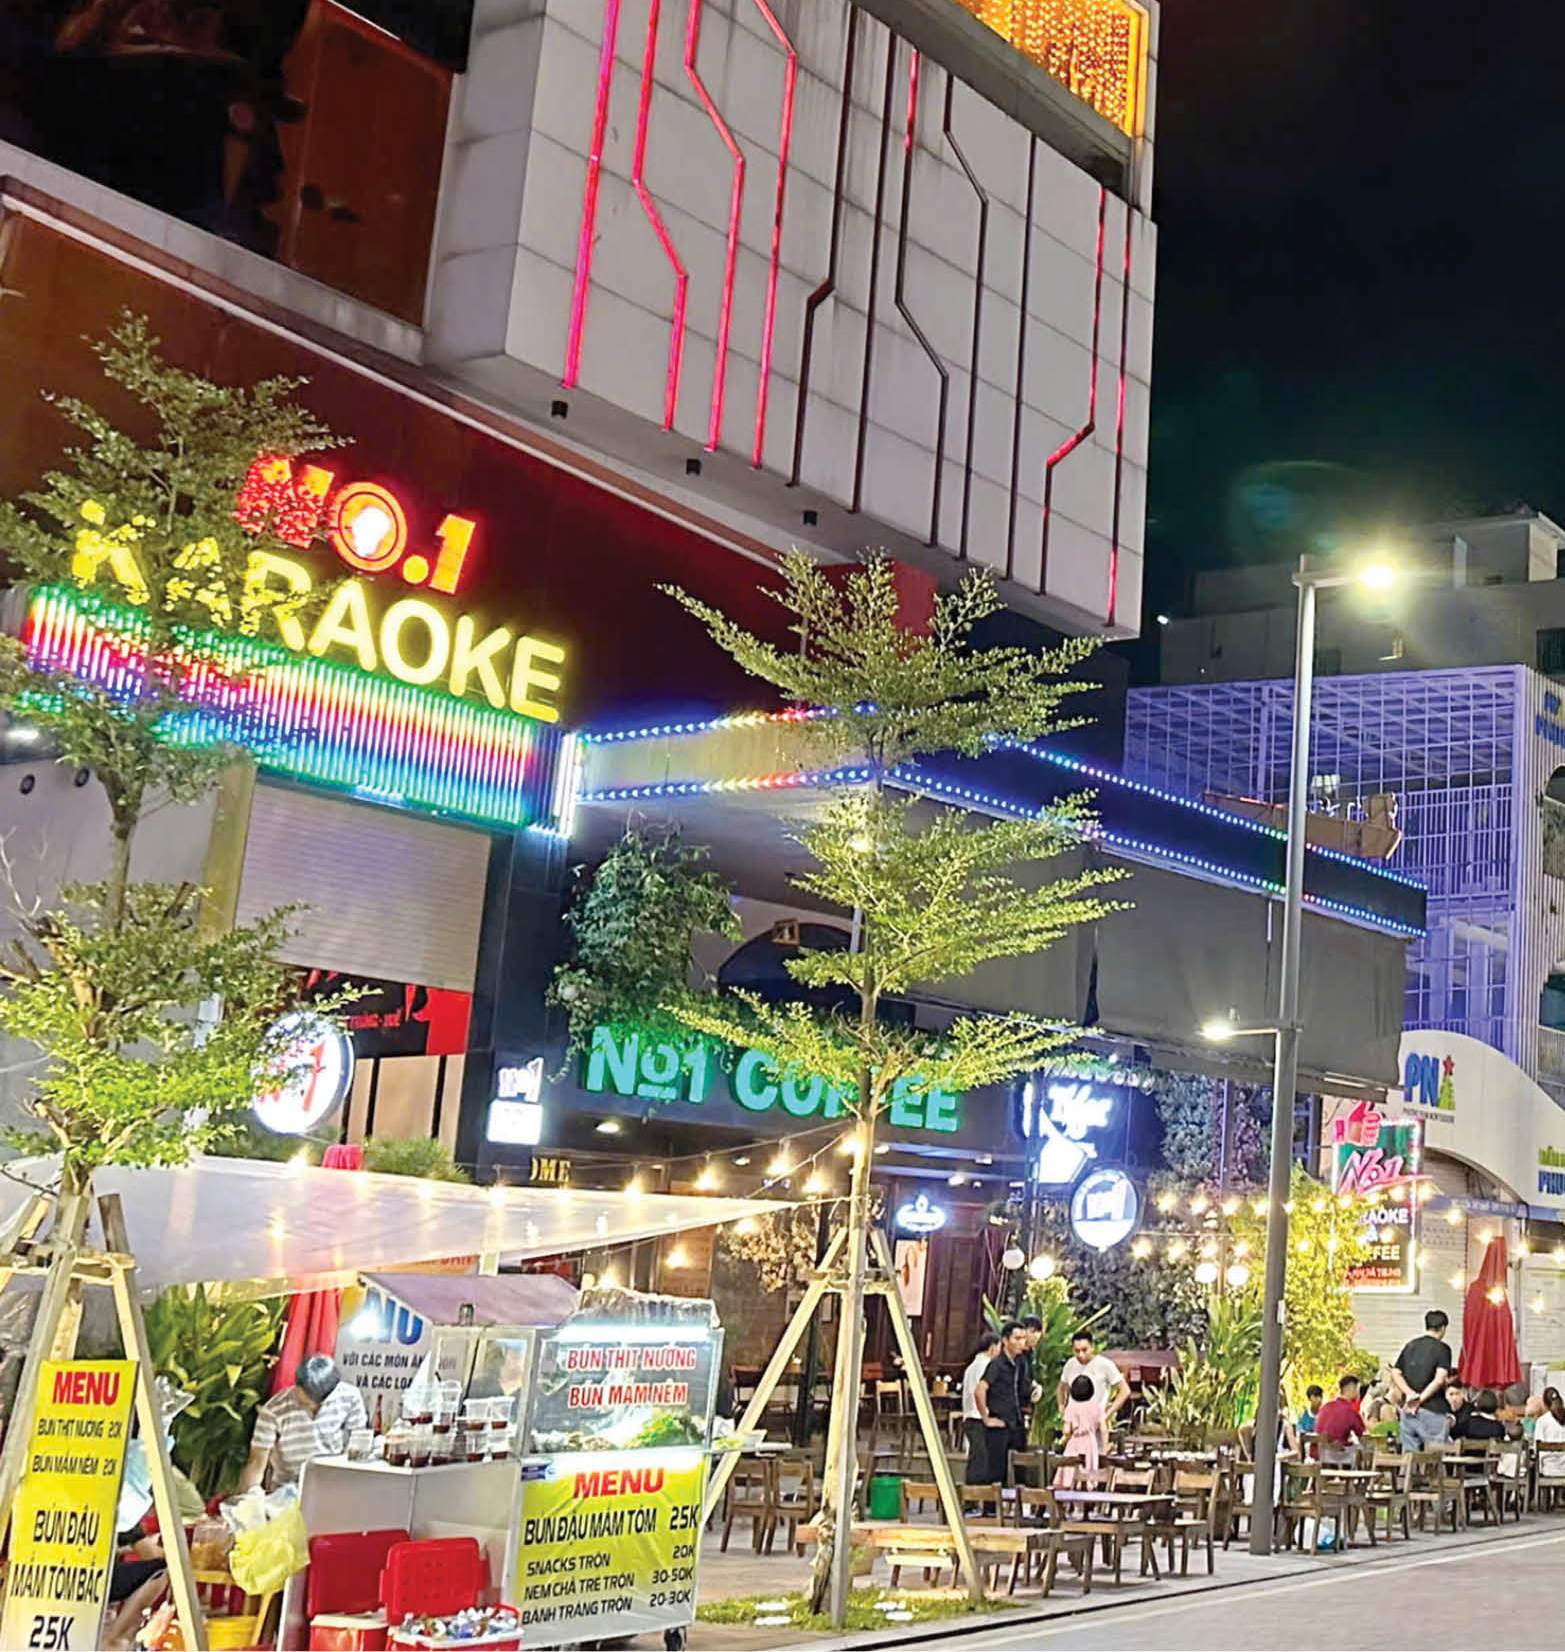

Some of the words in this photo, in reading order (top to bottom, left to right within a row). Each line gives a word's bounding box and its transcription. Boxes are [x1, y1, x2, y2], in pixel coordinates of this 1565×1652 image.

[72, 498, 567, 722] KARAOKE
[735, 1051, 958, 1132] COFEE
[52, 1371, 121, 1406] MENU
[573, 1468, 665, 1499] MENU
[669, 1504, 699, 1531] 25K
[526, 1557, 577, 1577] SNACKS
[672, 1545, 696, 1560] 20K
[29, 1615, 74, 1650] 25K
